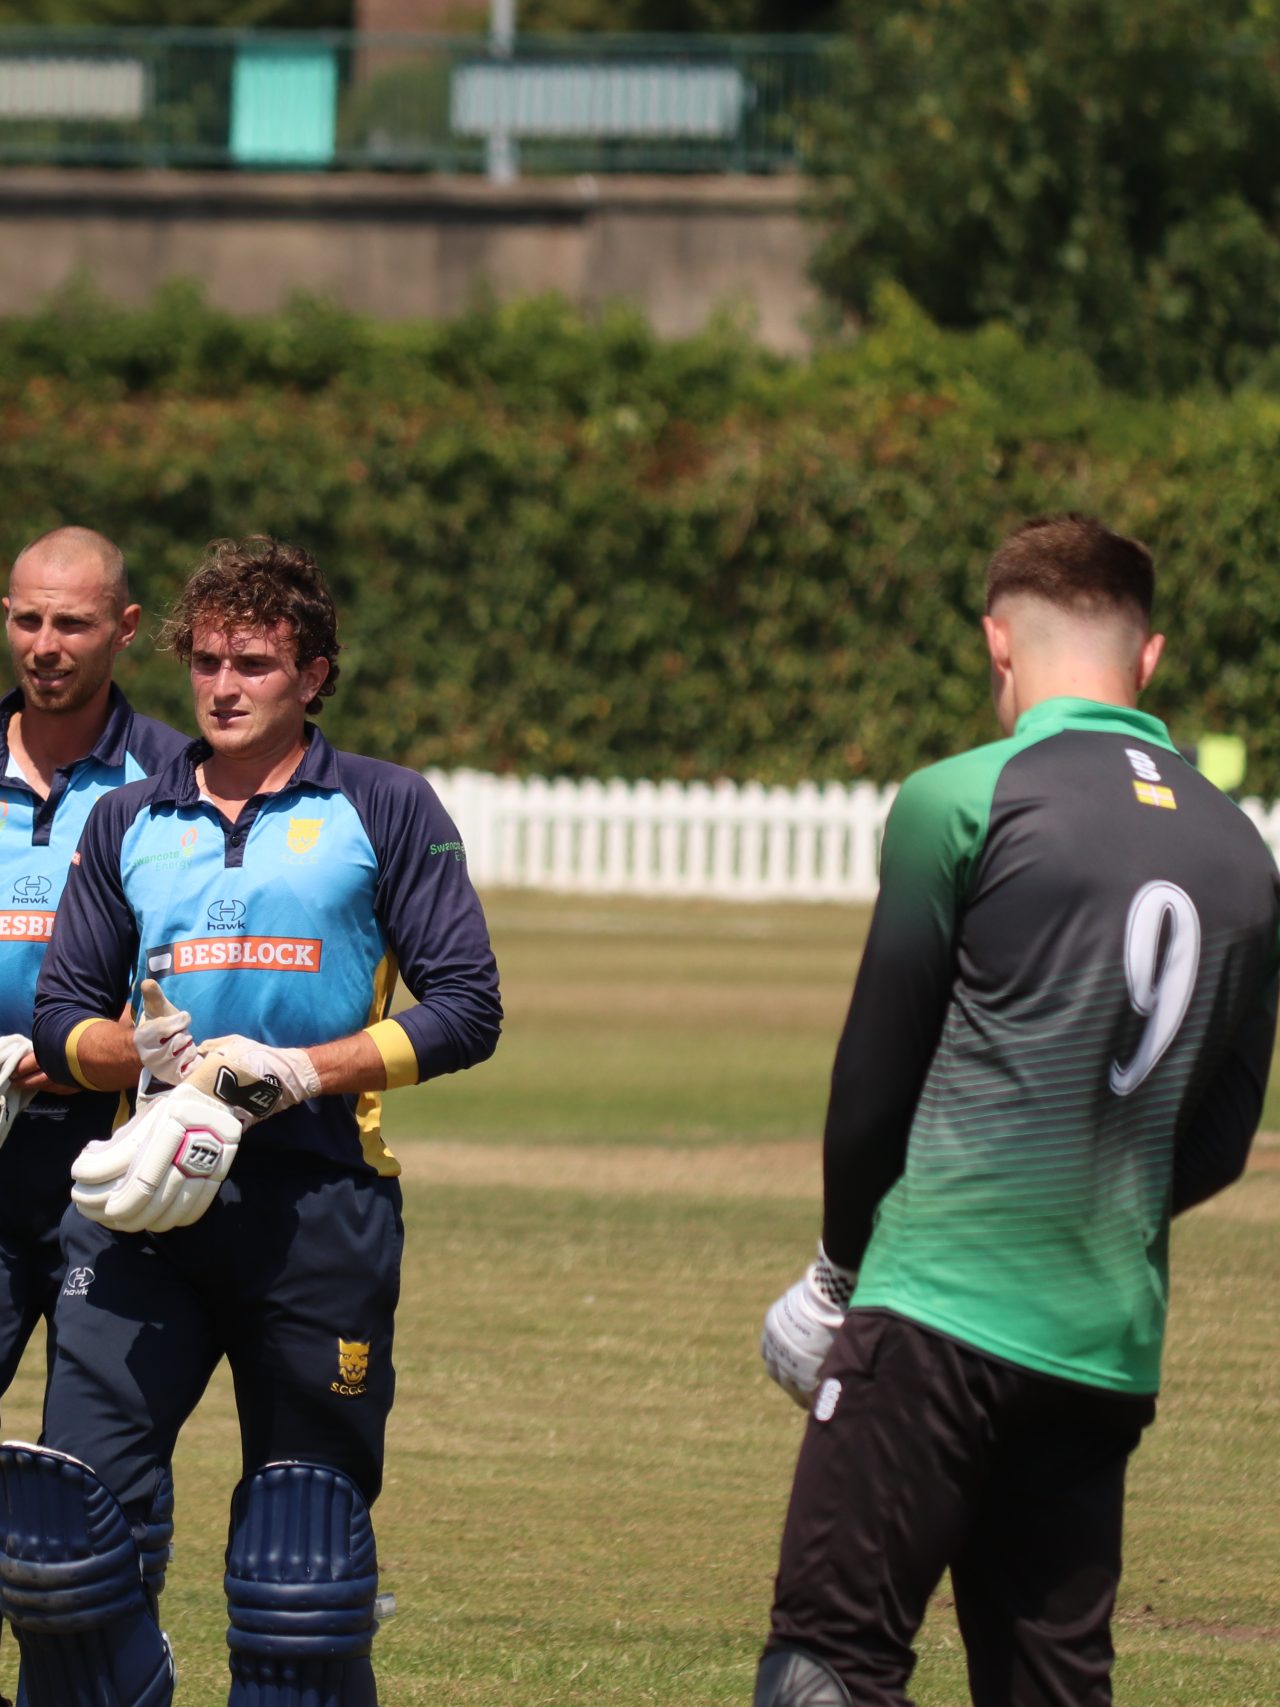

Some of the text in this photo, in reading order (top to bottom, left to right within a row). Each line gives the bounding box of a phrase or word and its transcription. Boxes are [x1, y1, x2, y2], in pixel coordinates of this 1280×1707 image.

[133, 850, 180, 867] wancote
[12, 895, 49, 904] hawk
[207, 920, 247, 931] hawk
[179, 942, 315, 968] BESBLOCK
[1109, 879, 1201, 1096] 9
[190, 1144, 219, 1165] 777
[63, 1287, 89, 1296] hawk
